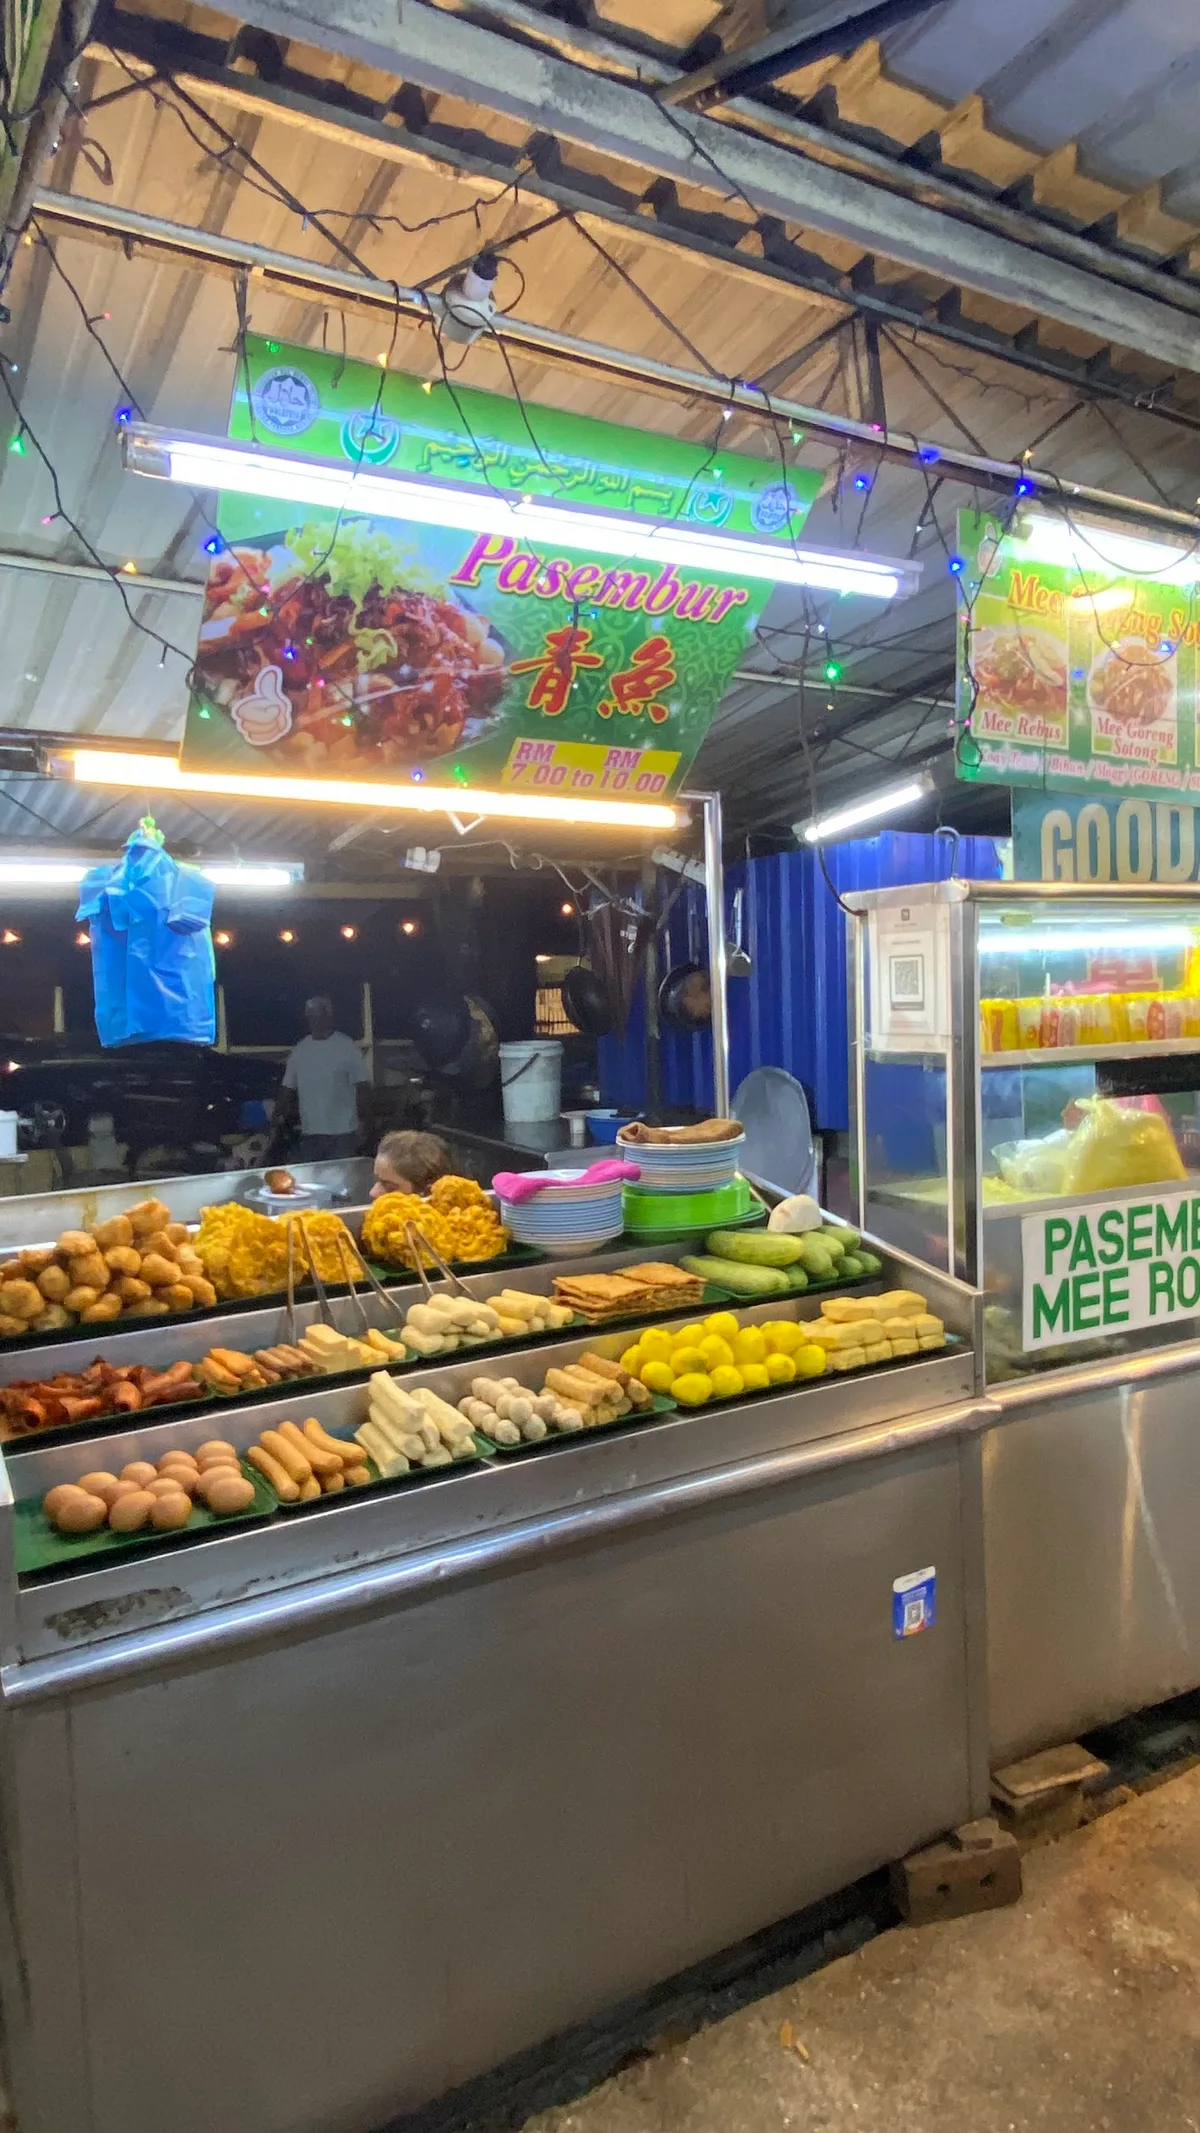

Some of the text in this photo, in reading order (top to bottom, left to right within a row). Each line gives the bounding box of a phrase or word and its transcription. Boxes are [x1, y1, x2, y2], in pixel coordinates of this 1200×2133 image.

[450, 532, 748, 623] Pasembur
[1008, 571, 1063, 618] Mee
[981, 711, 1061, 740] Mee Rebus
[1096, 717, 1174, 749] Mee Goreng
[515, 741, 642, 769] RM RM
[1113, 737, 1158, 763] Sotong
[510, 763, 667, 793] 7.00 to 10.00
[1033, 1267, 1129, 1339] MEE
